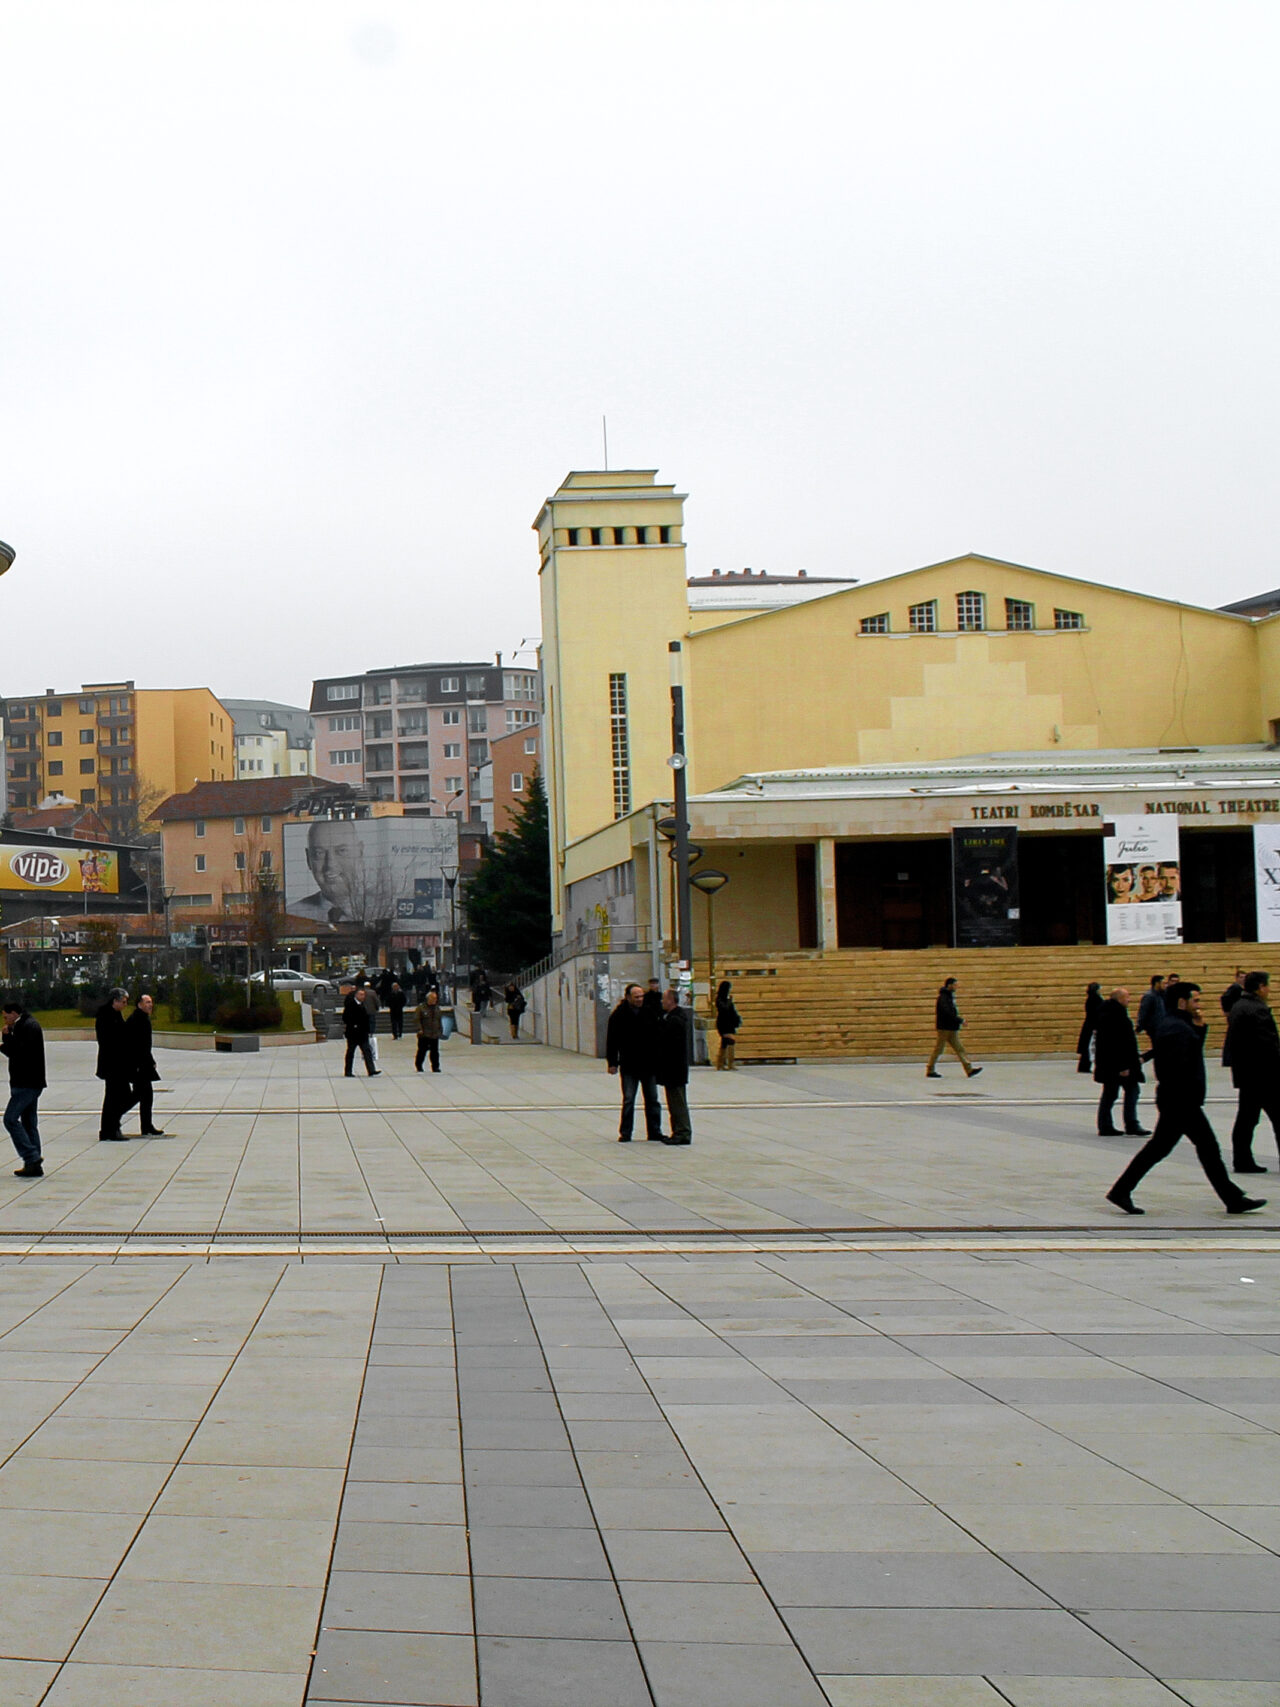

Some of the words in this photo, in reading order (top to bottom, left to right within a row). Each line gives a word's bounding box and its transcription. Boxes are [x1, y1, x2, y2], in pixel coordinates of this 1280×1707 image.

[971, 805, 1019, 819] TEATRI
[1030, 802, 1100, 818] KOMBËTAR
[1144, 801, 1210, 815] NATIONAL
[1218, 799, 1280, 813] THEATRE
[18, 853, 63, 882] vipa
